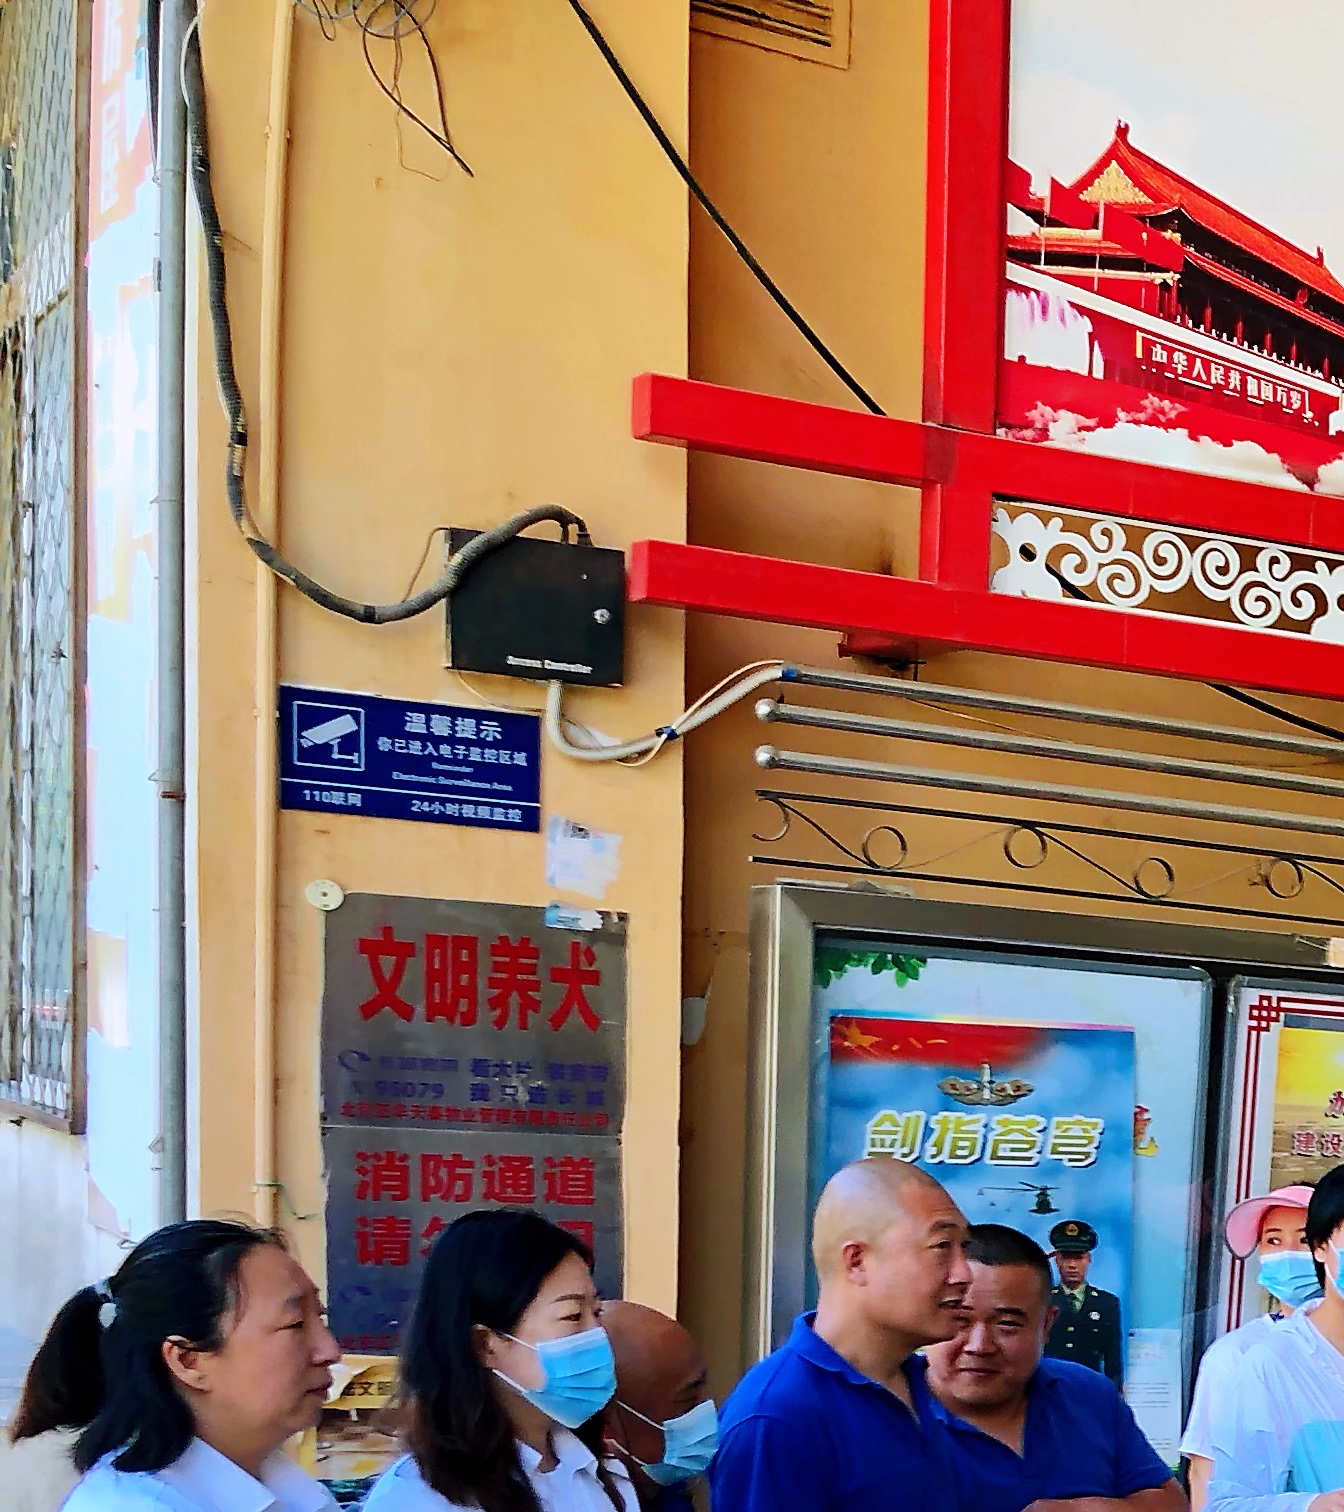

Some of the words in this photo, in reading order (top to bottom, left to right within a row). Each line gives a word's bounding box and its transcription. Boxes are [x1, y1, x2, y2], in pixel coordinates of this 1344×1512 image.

[404, 711, 502, 741] 温馨提示
[357, 925, 603, 1033] 文明养犬
[864, 1109, 1104, 1168] 剑指苍穹
[355, 1151, 596, 1205] 消防通道
